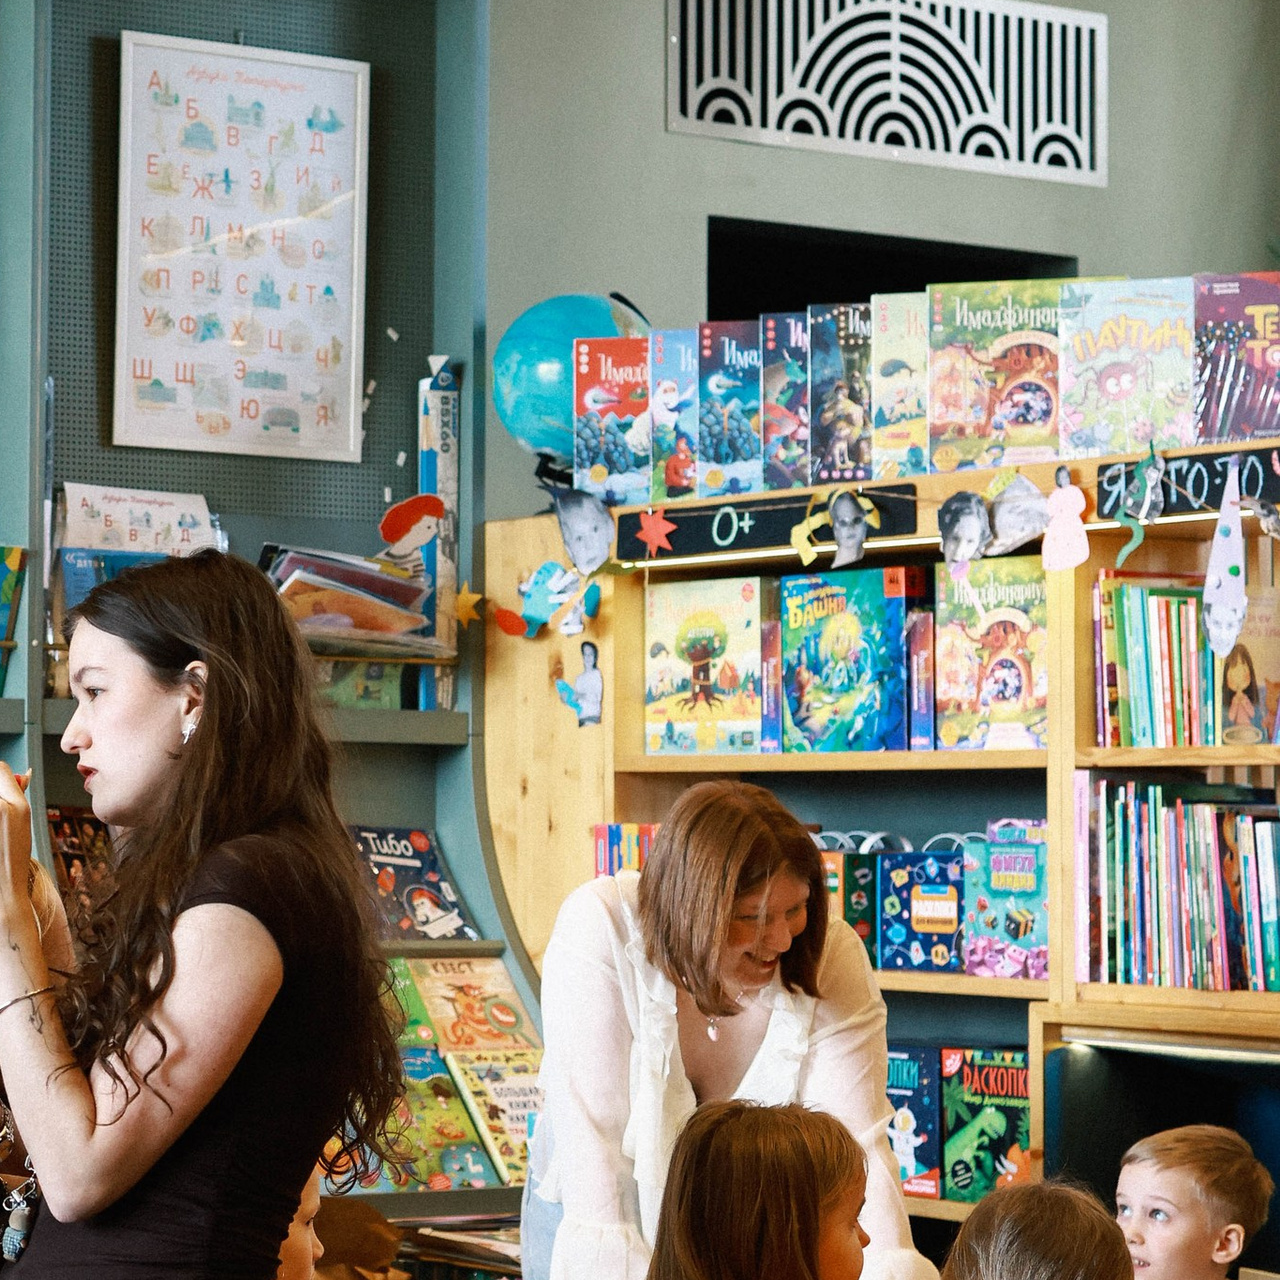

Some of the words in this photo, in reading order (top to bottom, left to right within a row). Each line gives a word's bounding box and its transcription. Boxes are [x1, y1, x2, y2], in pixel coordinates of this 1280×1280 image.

[148, 70, 162, 90] А
[187, 99, 199, 119] Б
[227, 126, 239, 146] В
[310, 132, 325, 155] Д
[192, 177, 214, 200] Ж
[141, 217, 155, 239] К
[179, 315, 197, 334] Ф
[133, 358, 152, 379] Ш
[240, 398, 259, 419] Ю
